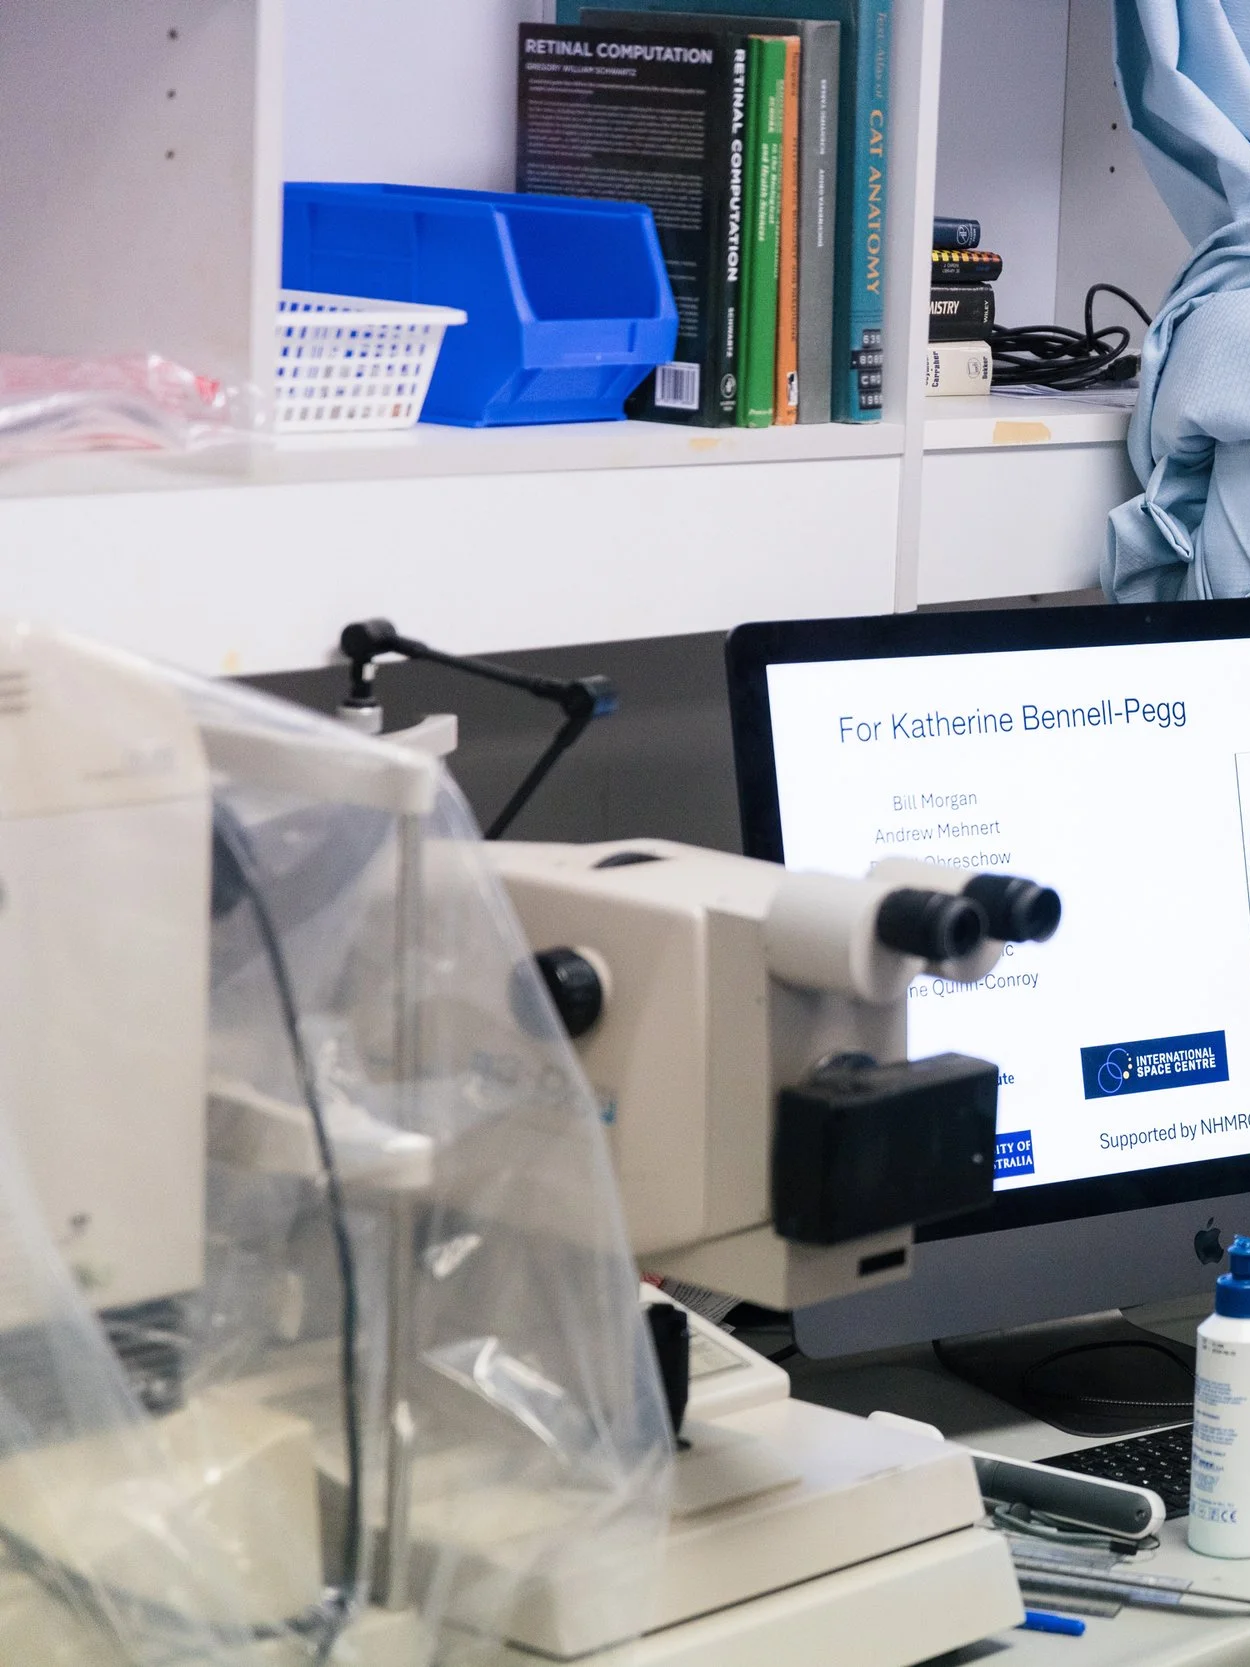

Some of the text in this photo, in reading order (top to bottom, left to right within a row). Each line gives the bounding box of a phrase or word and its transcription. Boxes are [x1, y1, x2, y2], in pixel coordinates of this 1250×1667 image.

[525, 38, 713, 64] RETINAL COMPUTATION
[732, 48, 747, 133] RETINAL
[869, 109, 883, 157] CAT
[727, 140, 743, 282] COMPUTATION
[866, 166, 882, 295] ANATOMY
[929, 301, 960, 315] MISTRY
[839, 698, 1187, 743] For Katherine Bennell-Pegg
[892, 791, 978, 812] Bill Morgan
[874, 820, 1001, 845] Andrew Mehnert
[1136, 1047, 1215, 1067] INTERNATIONAL
[1137, 1057, 1216, 1078] SPACE CENTRE
[1017, 1140, 1031, 1152] OF
[1100, 1123, 1176, 1150] Supported
[1180, 1122, 1197, 1140] by
[993, 1155, 1033, 1170] TRALIA
